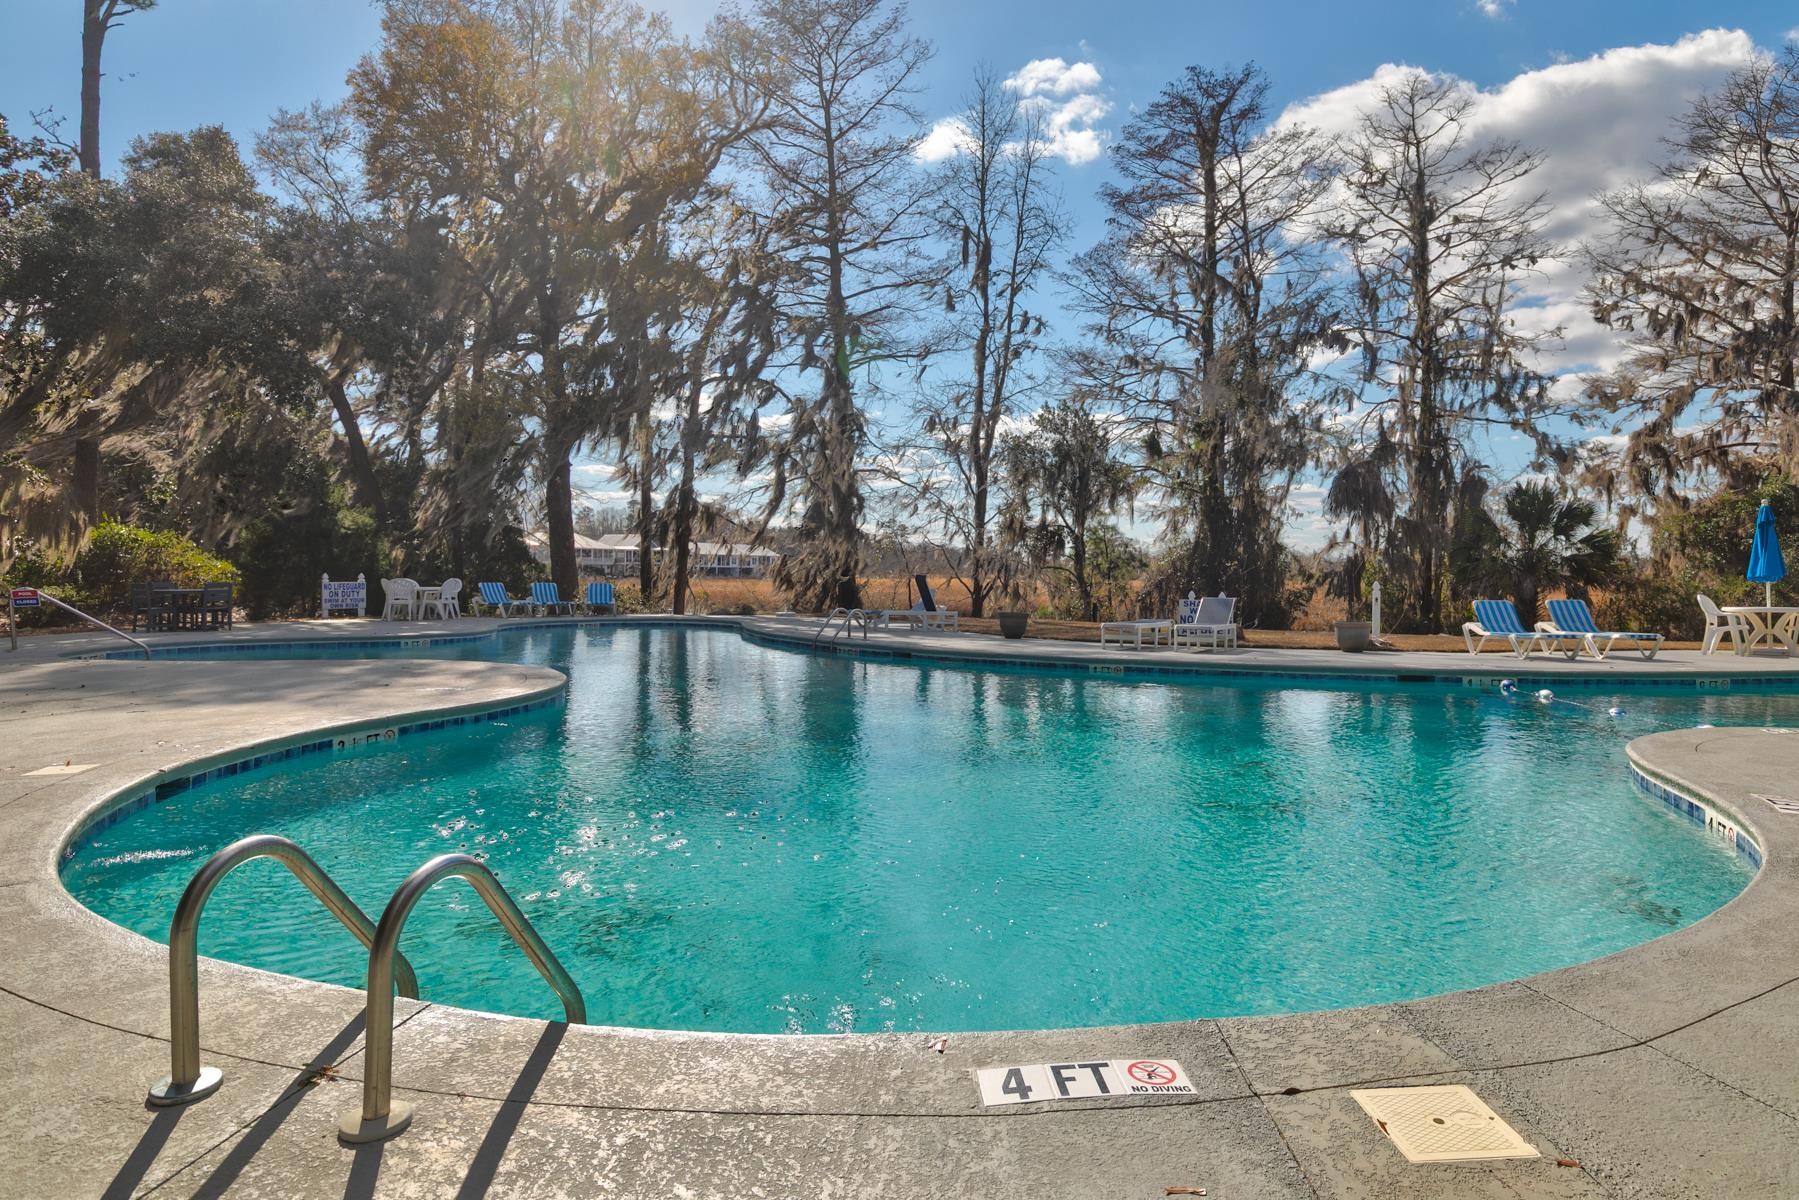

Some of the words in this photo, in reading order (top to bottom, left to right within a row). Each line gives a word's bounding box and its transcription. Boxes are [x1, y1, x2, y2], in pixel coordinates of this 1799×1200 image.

[323, 583, 332, 591] NO
[333, 583, 366, 591] LIFEGUARD
[1180, 615, 1194, 624] NO
[1001, 1067, 1033, 1100] 4
[1049, 1062, 1111, 1097] FT
[1131, 1085, 1149, 1093] NO
[1150, 1085, 1192, 1093] DIVING
